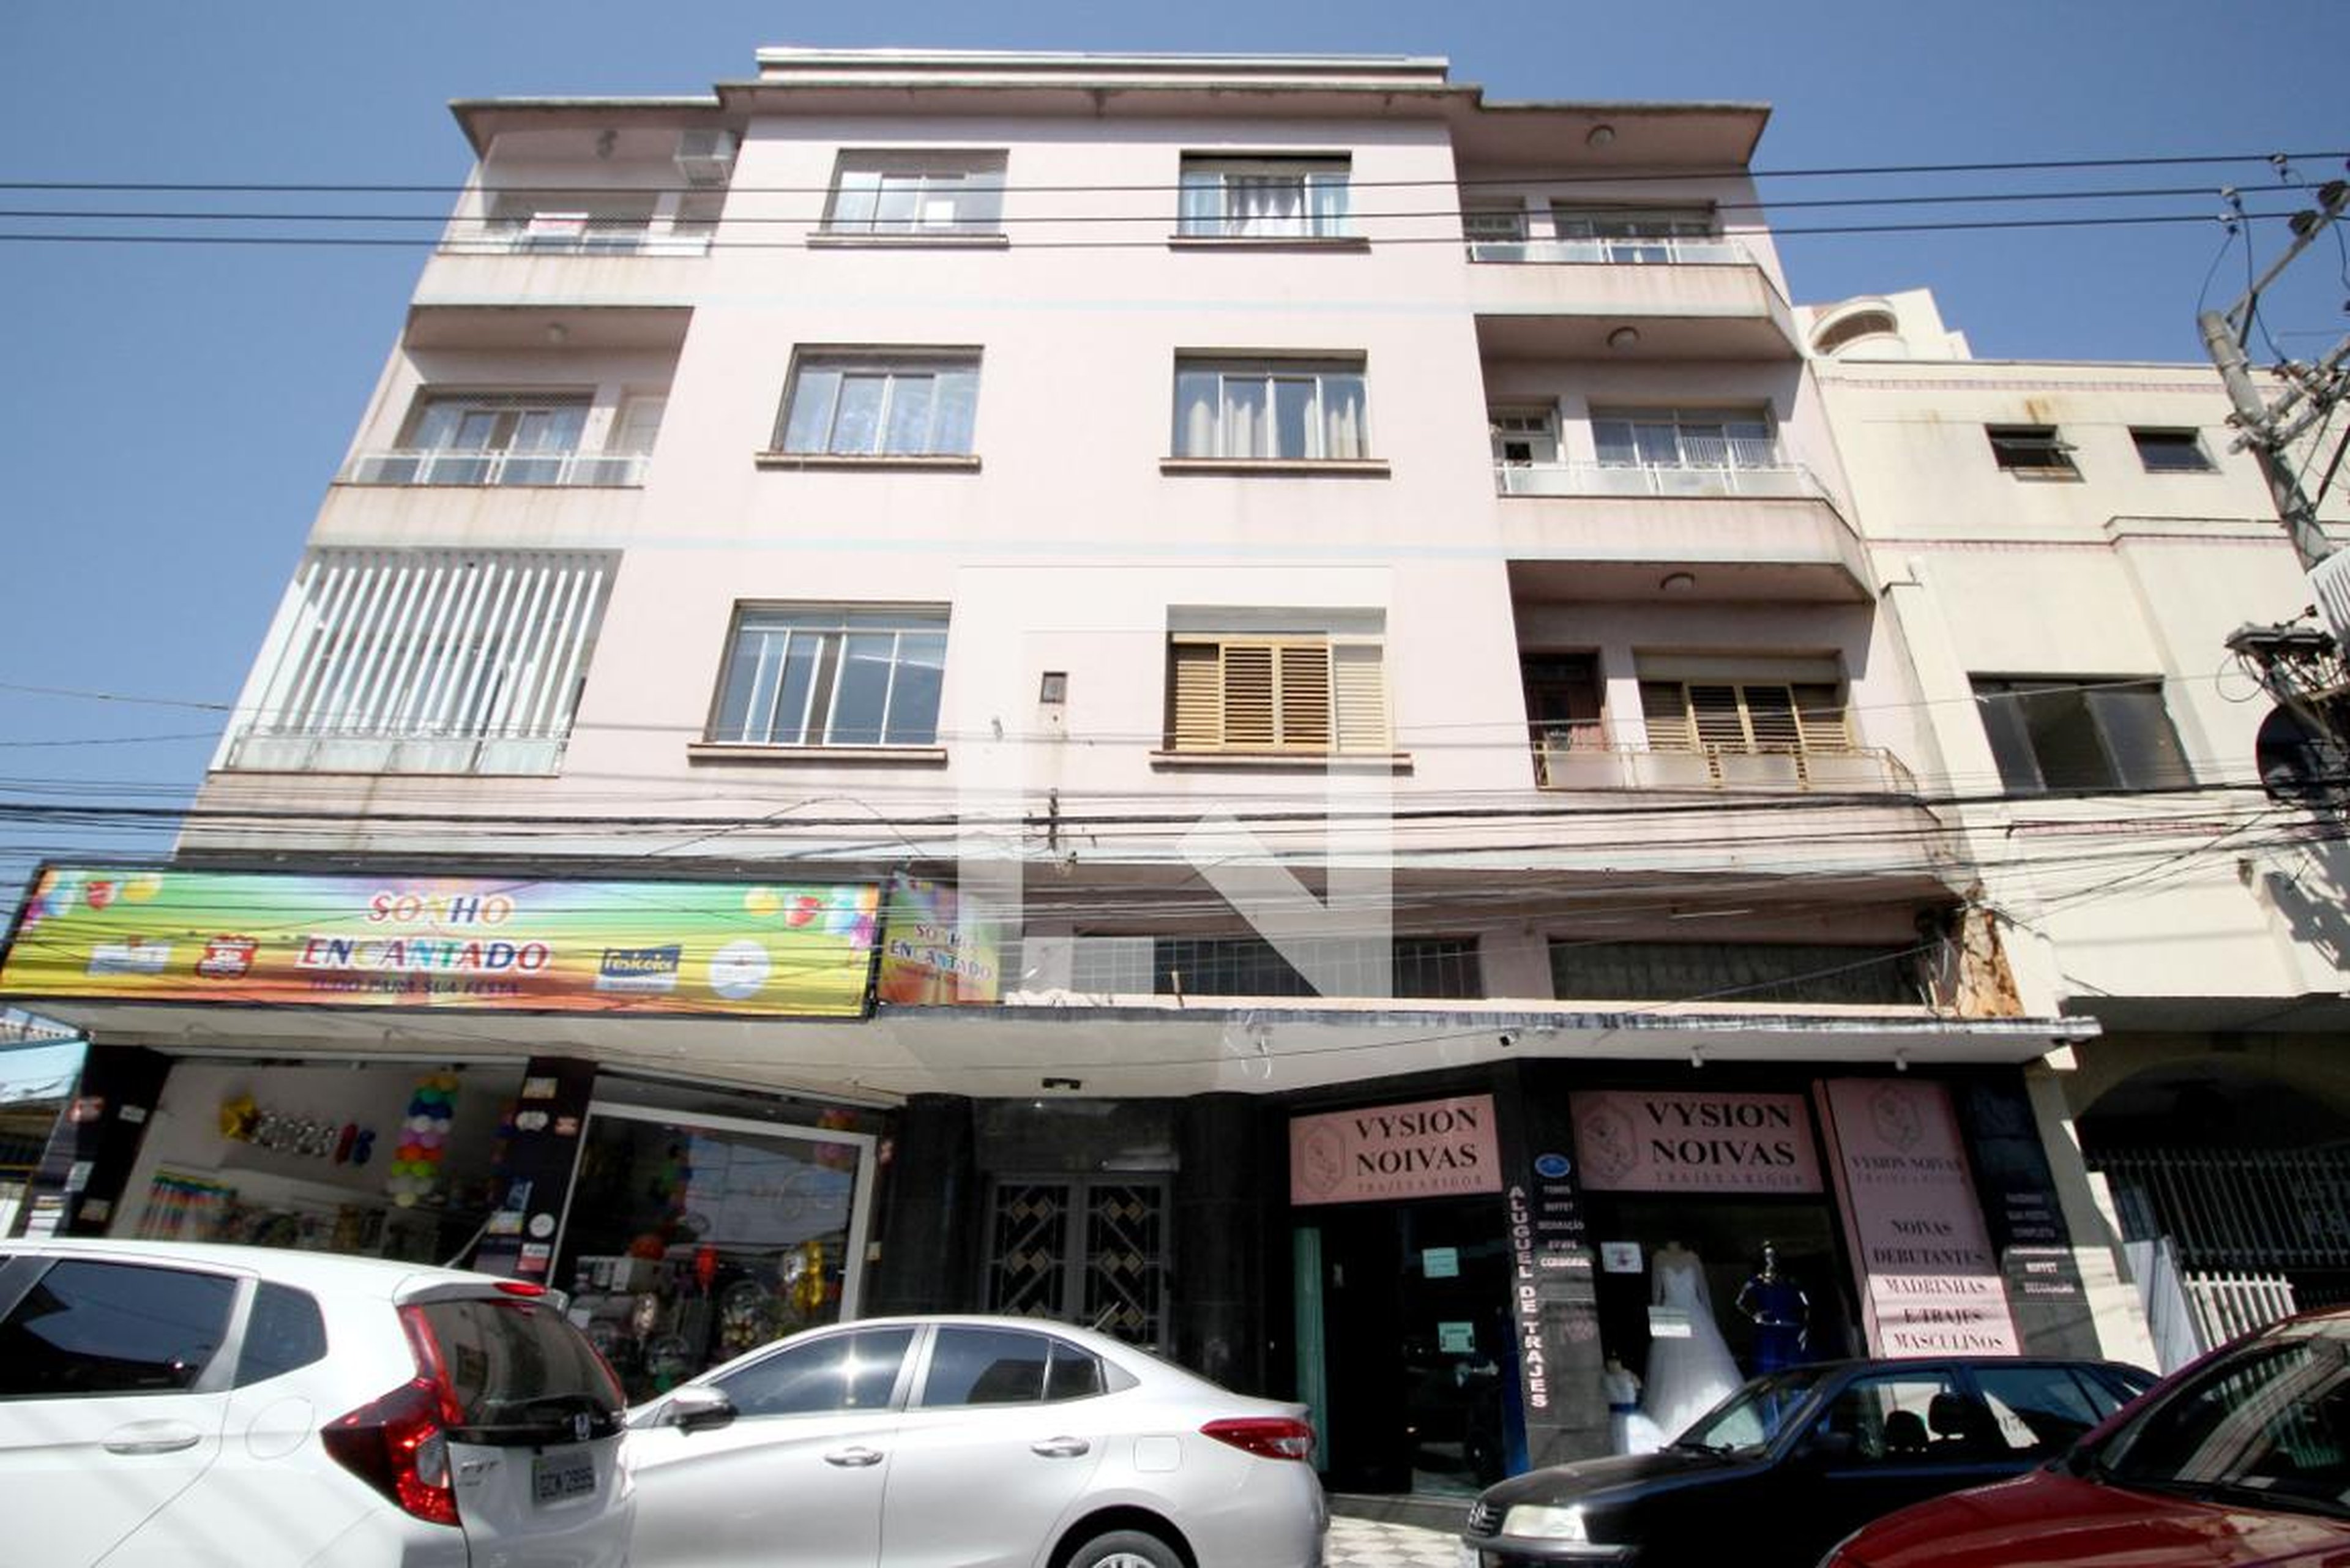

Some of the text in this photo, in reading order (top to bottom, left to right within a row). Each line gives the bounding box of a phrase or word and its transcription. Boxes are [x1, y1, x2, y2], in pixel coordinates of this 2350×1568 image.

[368, 895, 512, 924] SONHO
[302, 938, 550, 970] ENCANTADO
[1355, 1107, 1478, 1140] VYSION
[1646, 1102, 1791, 1129] VYSION
[1356, 1143, 1478, 1177] NOIVAS
[1651, 1140, 1796, 1166] NOIVAS
[1890, 1219, 1953, 1236] NOIVAS
[1872, 1249, 1986, 1264] DEBUTANTES
[1509, 1185, 1548, 1408] ALUGUEL DE TRAJES
[1884, 1279, 1988, 1294] MADRINHAS
[1903, 1308, 1984, 1324] E TRAJES
[1893, 1334, 2004, 1350] MASCULINOS
